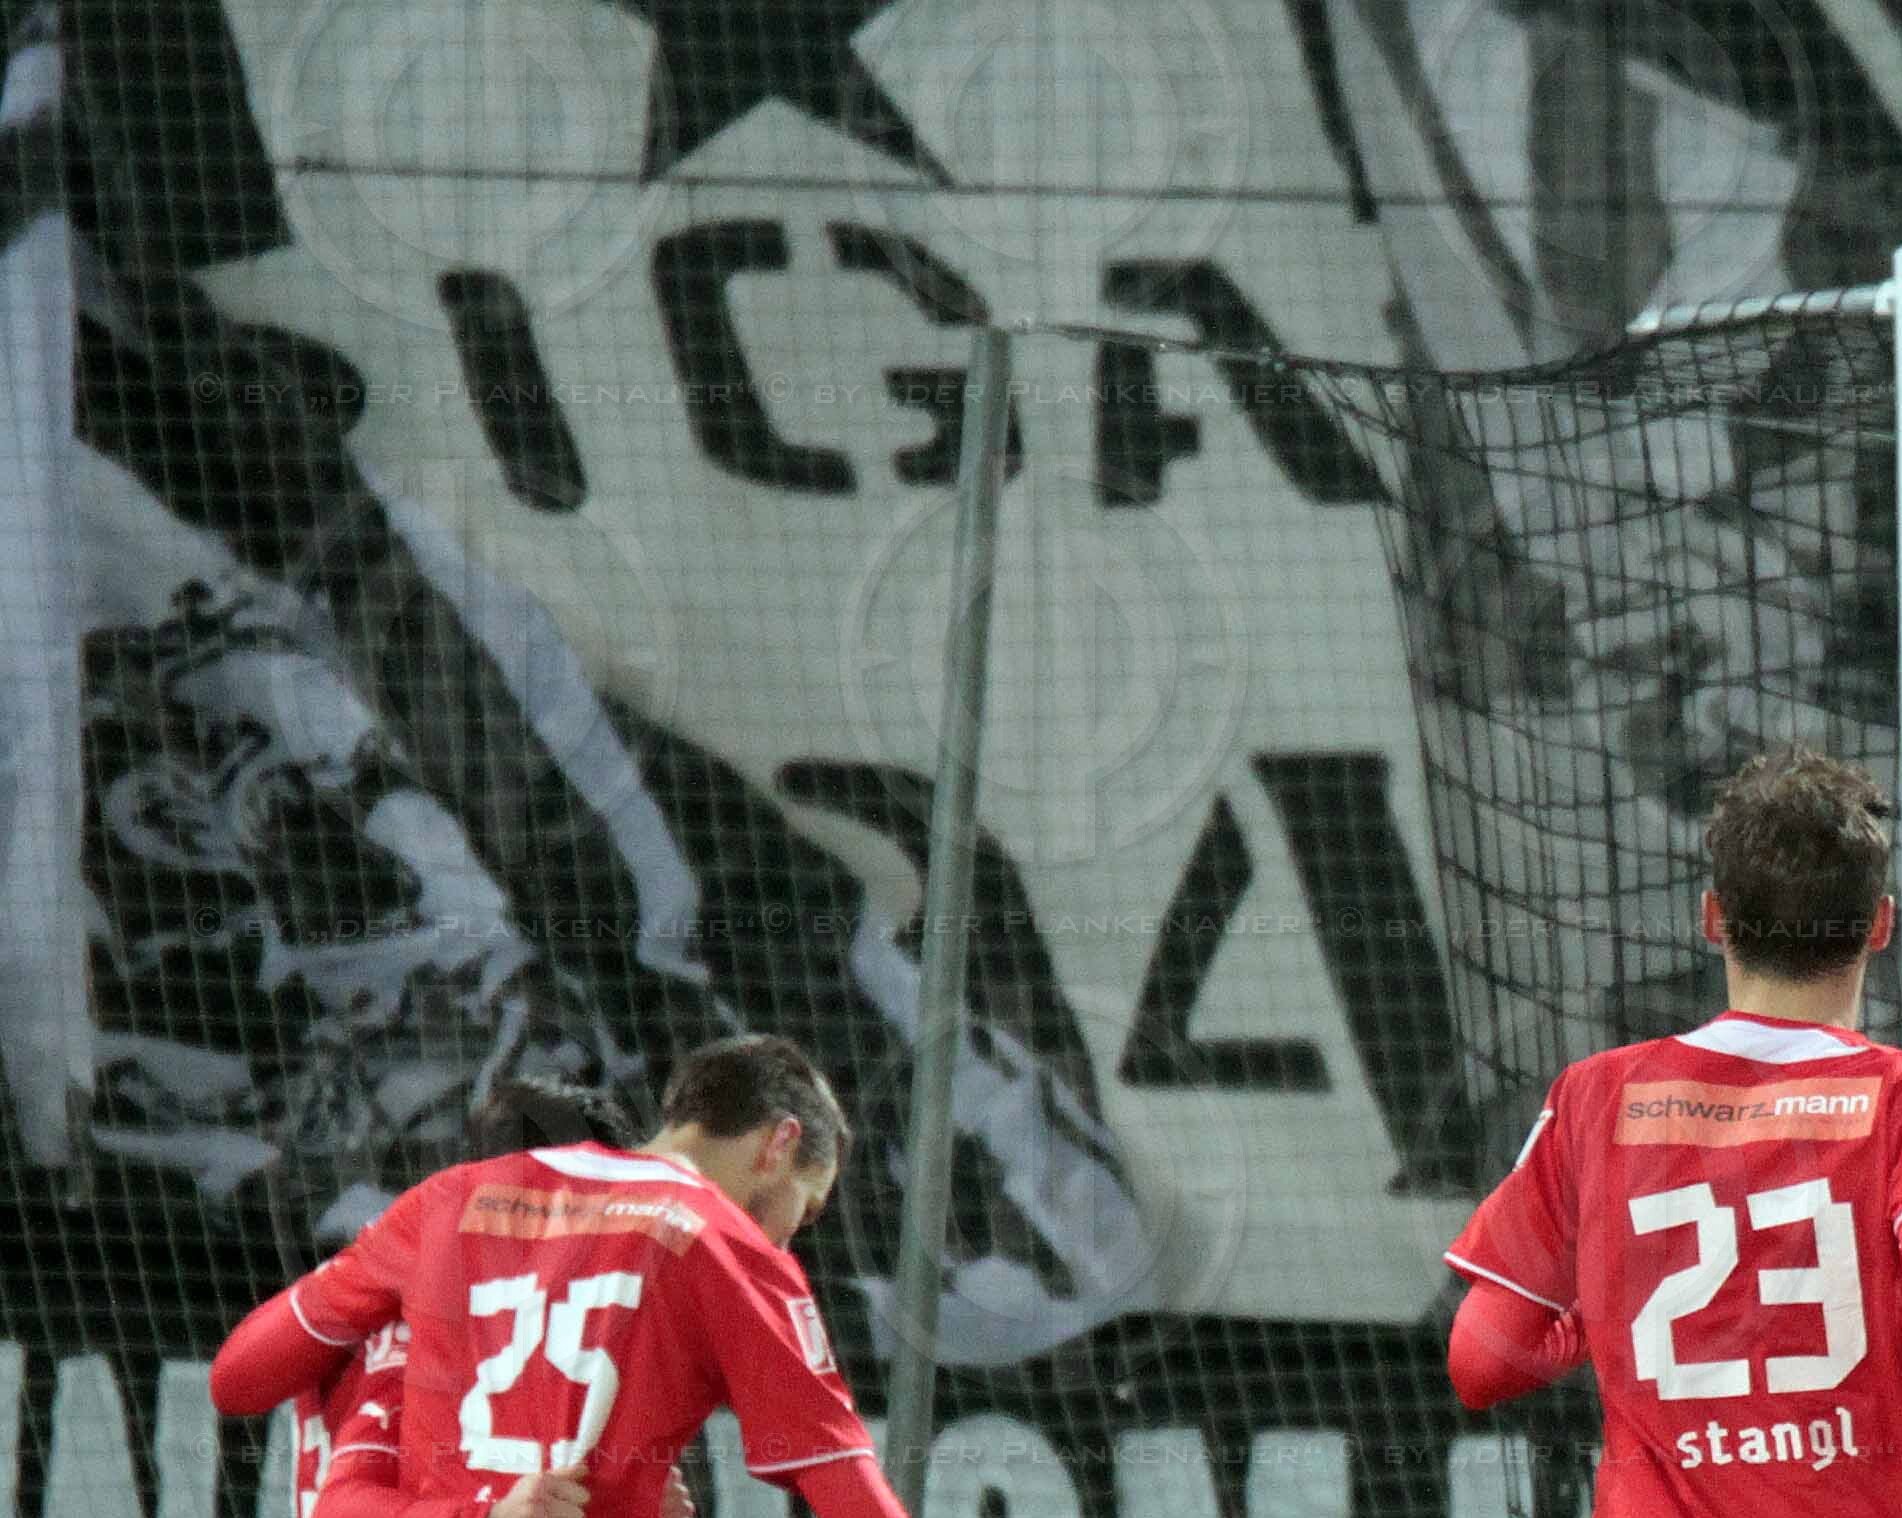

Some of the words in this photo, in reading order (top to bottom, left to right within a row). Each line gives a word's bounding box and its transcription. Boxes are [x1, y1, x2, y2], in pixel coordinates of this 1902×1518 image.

[459, 1271, 644, 1474] 25
[1628, 1177, 1867, 1400] 23
[1676, 1408, 1861, 1472] stangl
